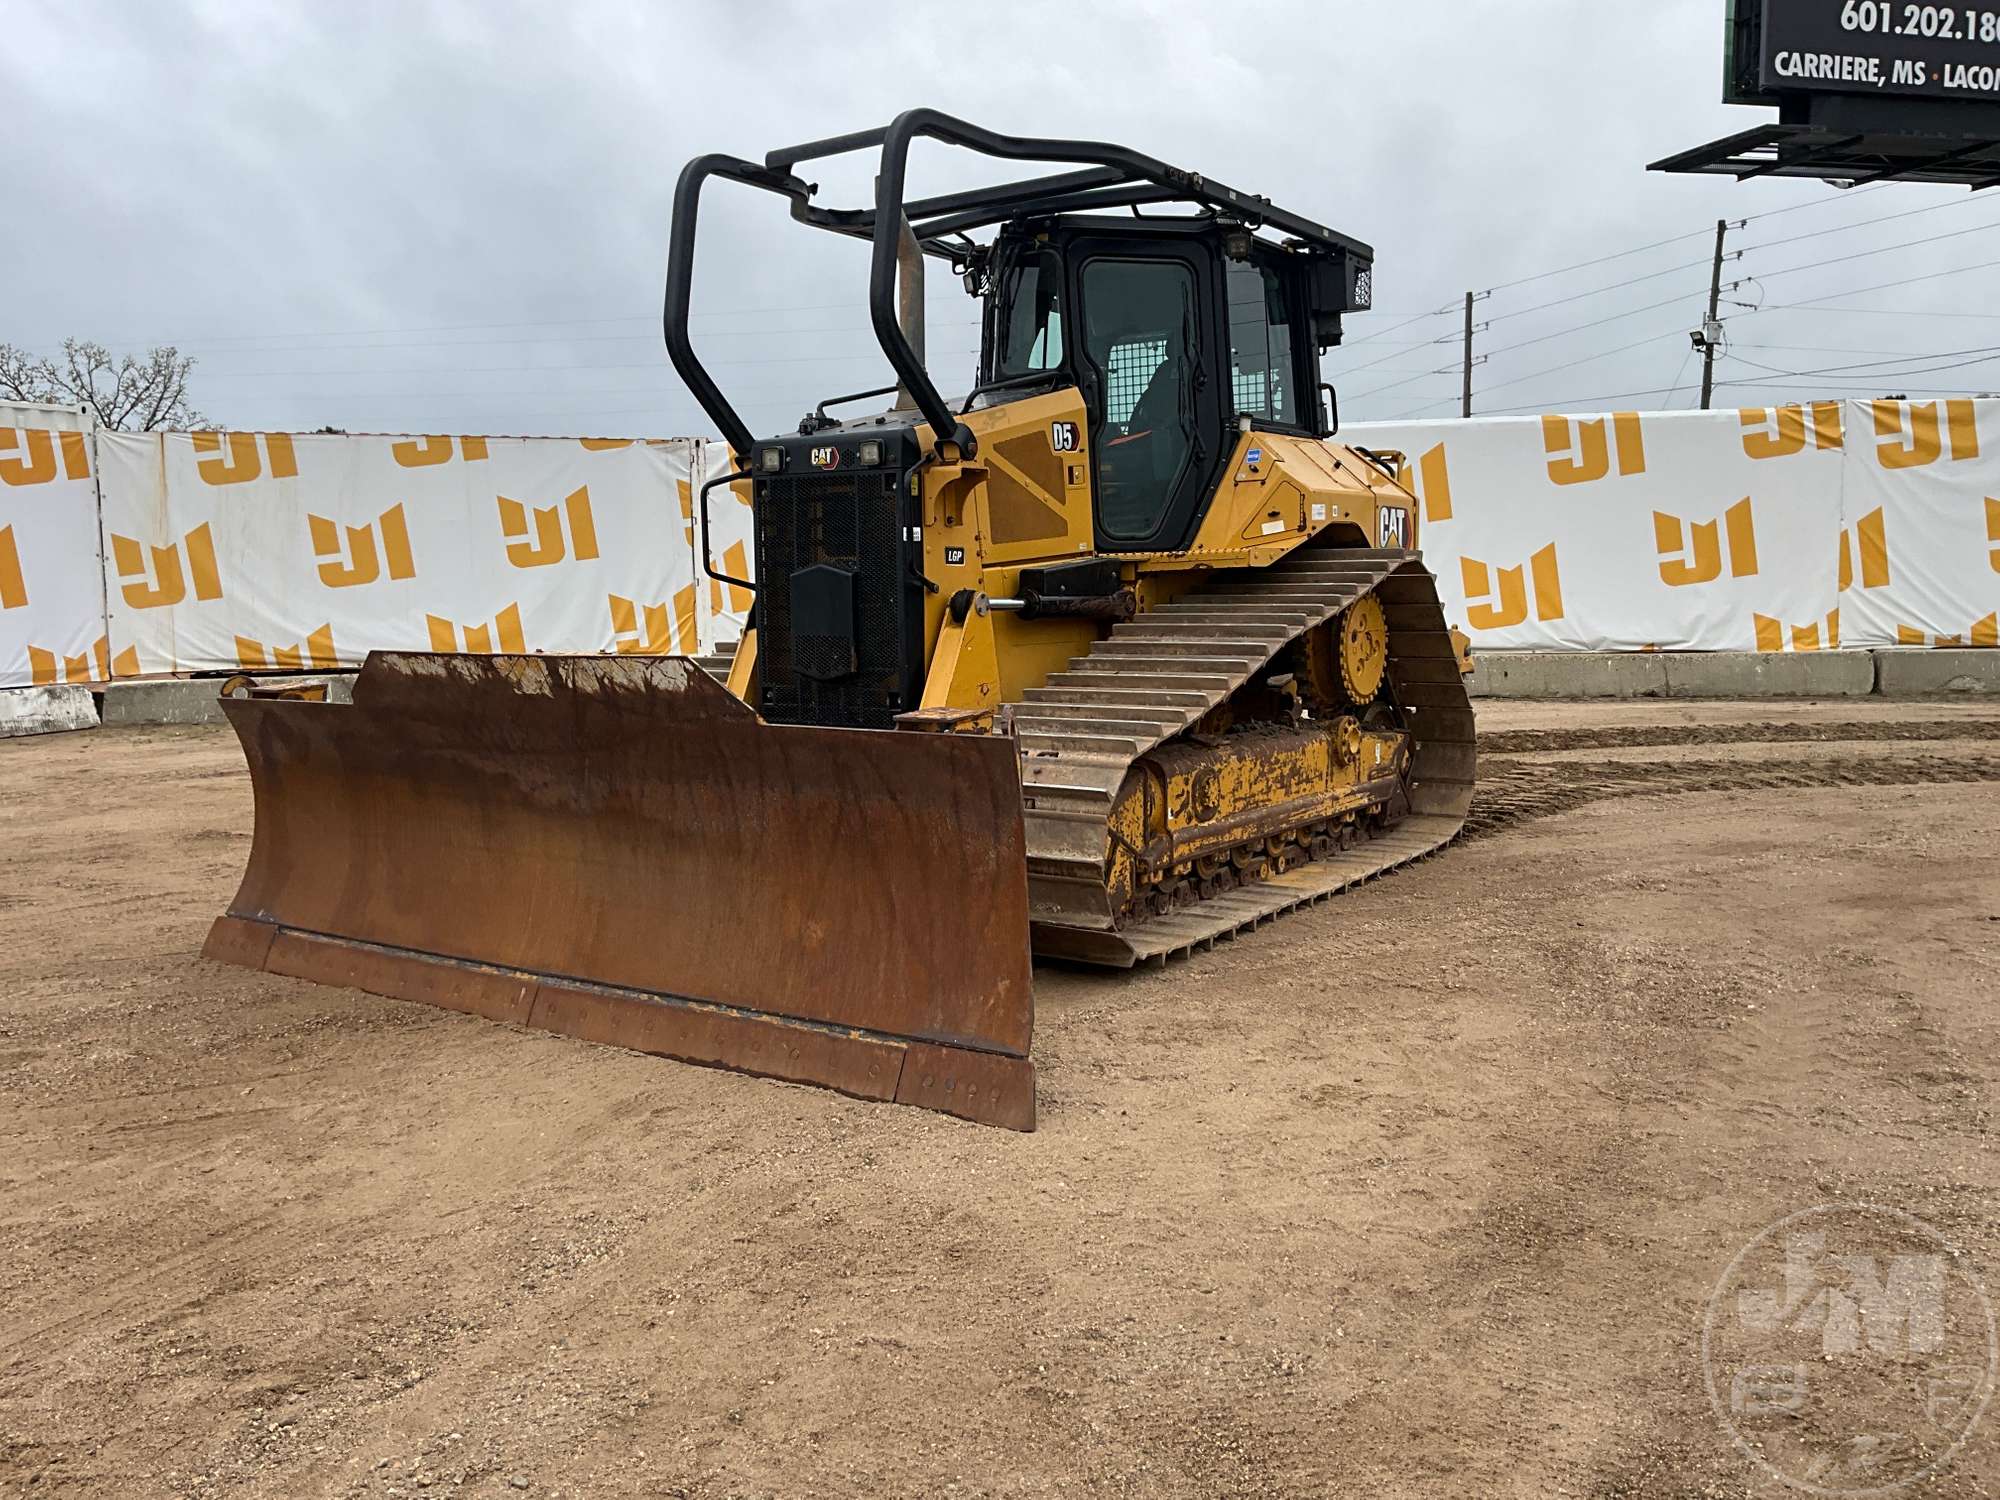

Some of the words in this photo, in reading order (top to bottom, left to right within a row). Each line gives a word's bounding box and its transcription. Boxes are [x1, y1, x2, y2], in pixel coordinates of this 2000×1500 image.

[1840, 0, 2000, 43] 601.202.18
[1774, 51, 1886, 88] CARRIERE,
[1891, 59, 1926, 86] MS
[1052, 422, 1074, 452] D5
[811, 447, 834, 466] CAT
[1379, 506, 1407, 548] CAT
[947, 550, 963, 562] LGP
